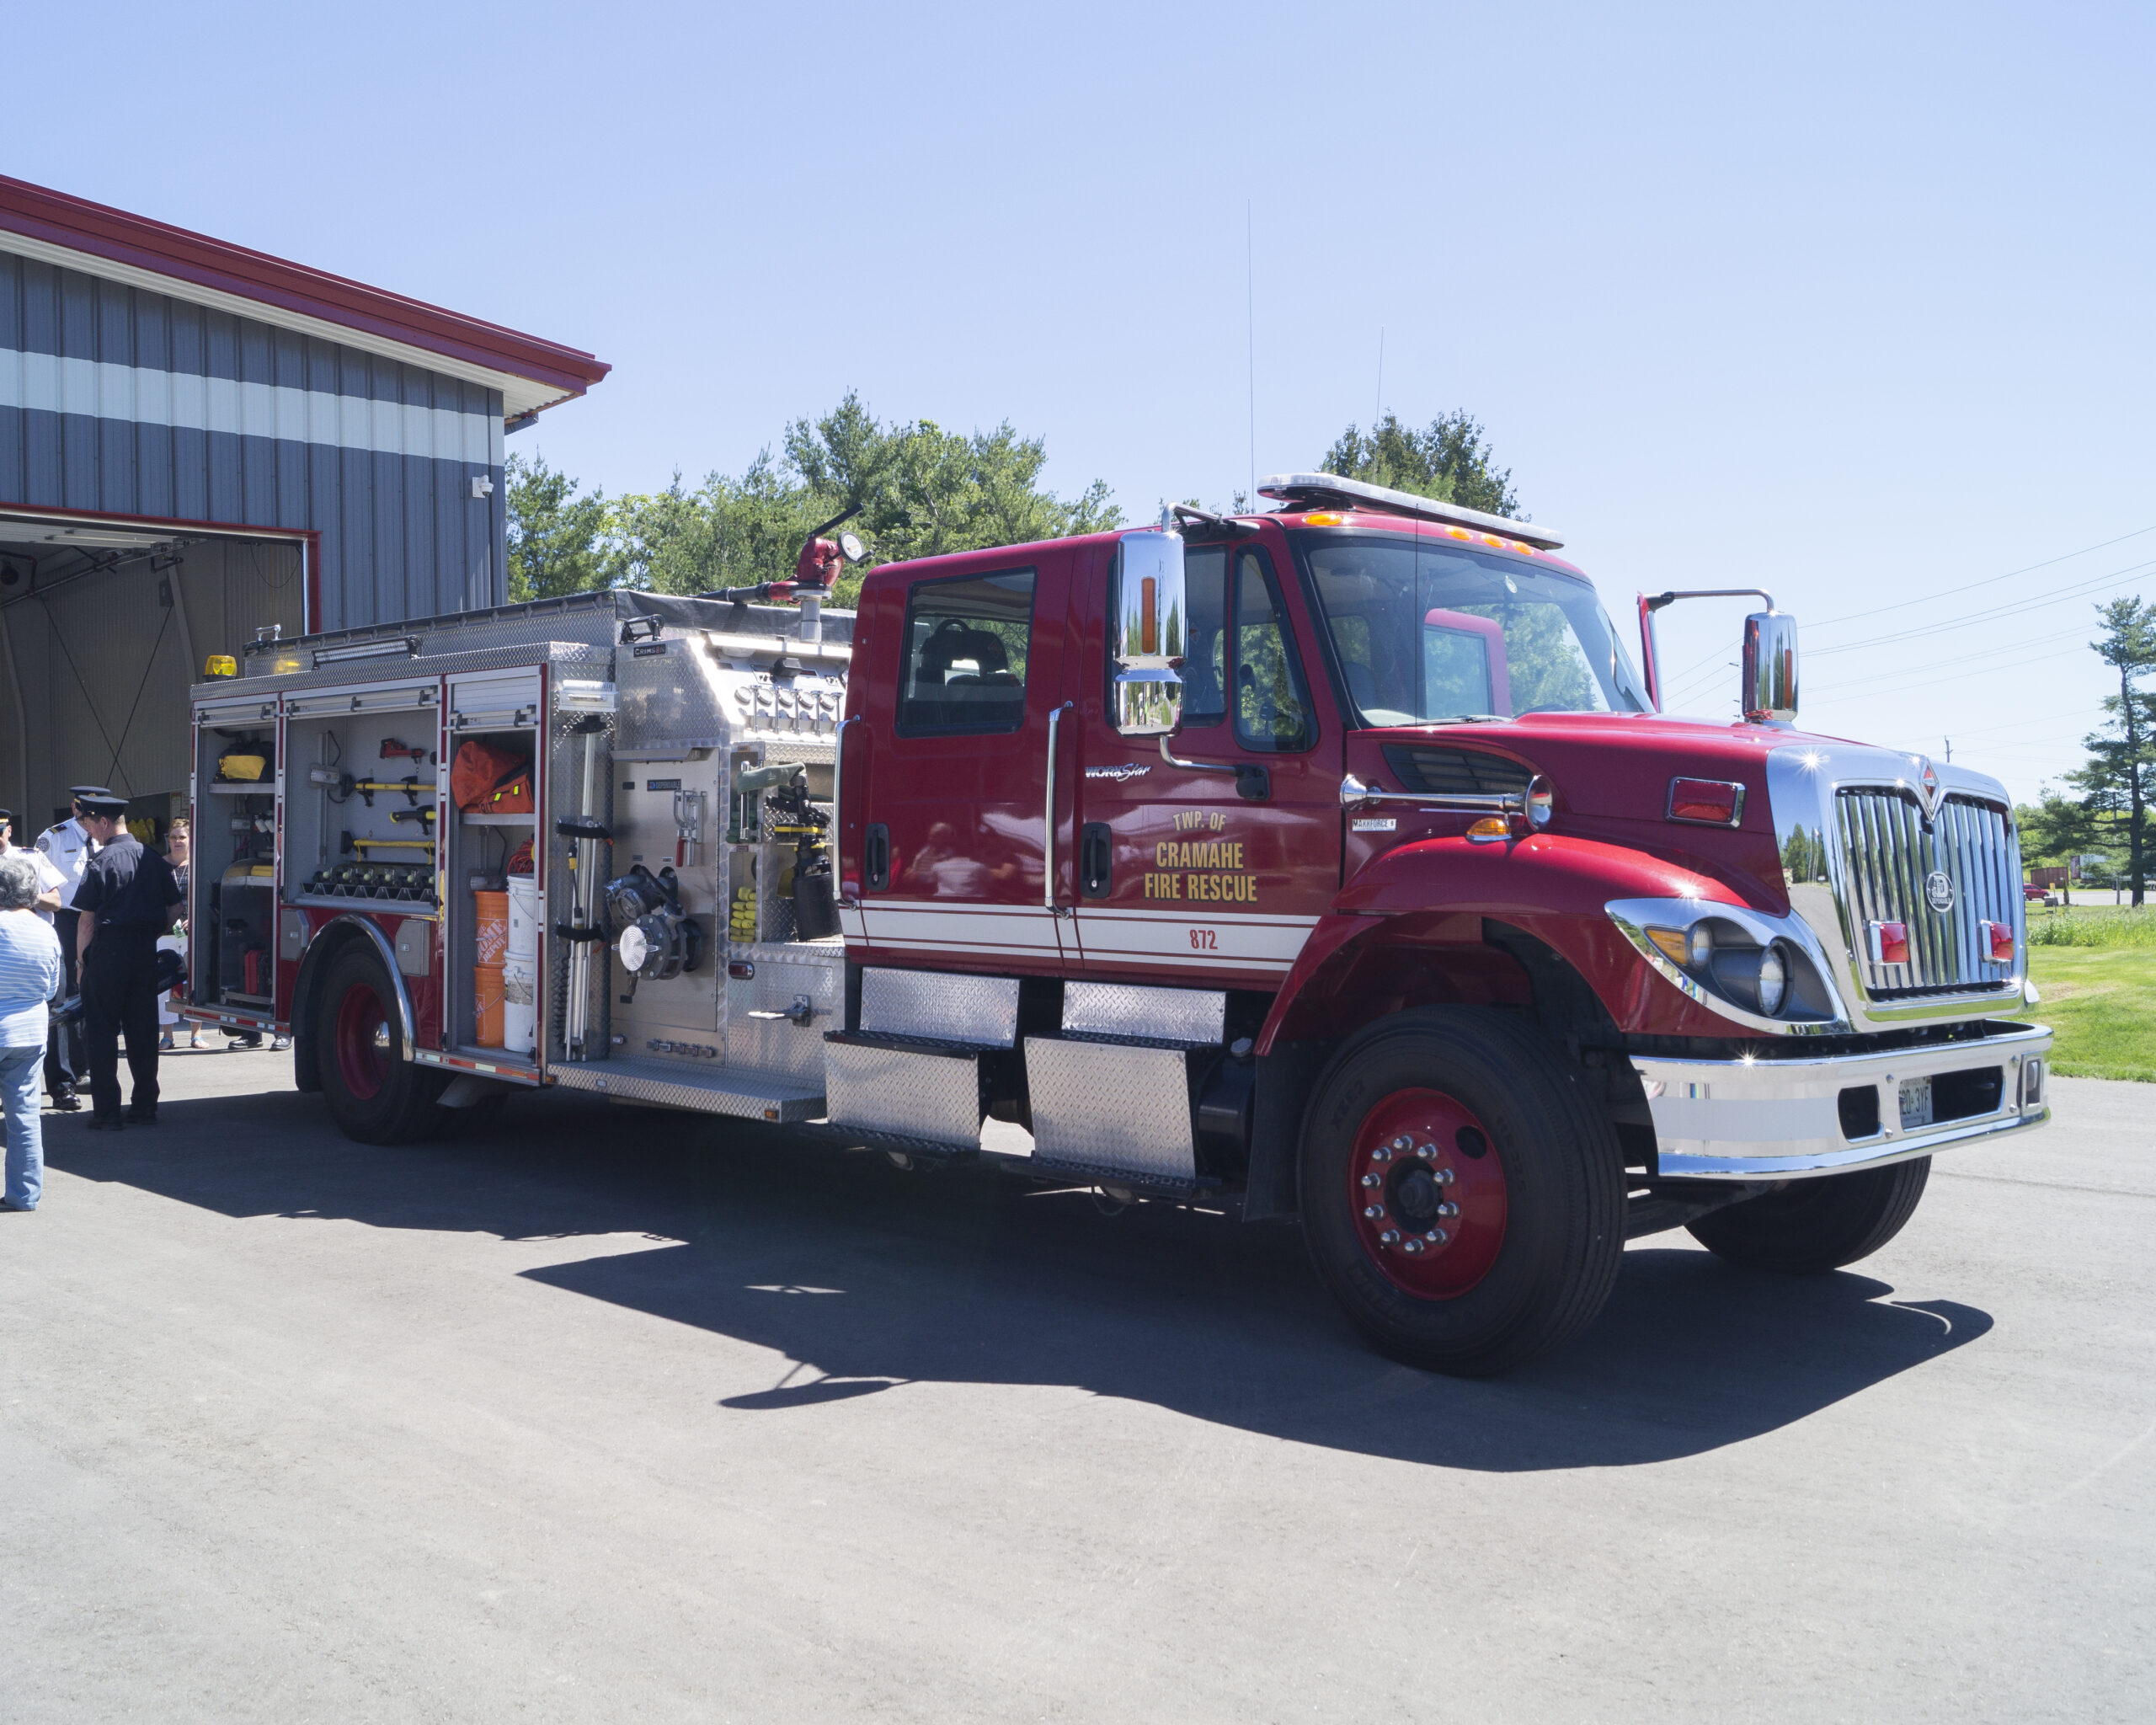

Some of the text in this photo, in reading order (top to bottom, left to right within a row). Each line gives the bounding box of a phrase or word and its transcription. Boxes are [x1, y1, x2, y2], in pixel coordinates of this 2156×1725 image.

[634, 647, 665, 655] CRIMSON
[1173, 810, 1226, 832] TWP. OF
[1155, 841, 1244, 869] CRAMAHE
[1144, 873, 1258, 903] FIRE RESCUE
[478, 919, 506, 961] HOME
[483, 937, 506, 962] DEPOT
[1189, 929, 1218, 950] 872
